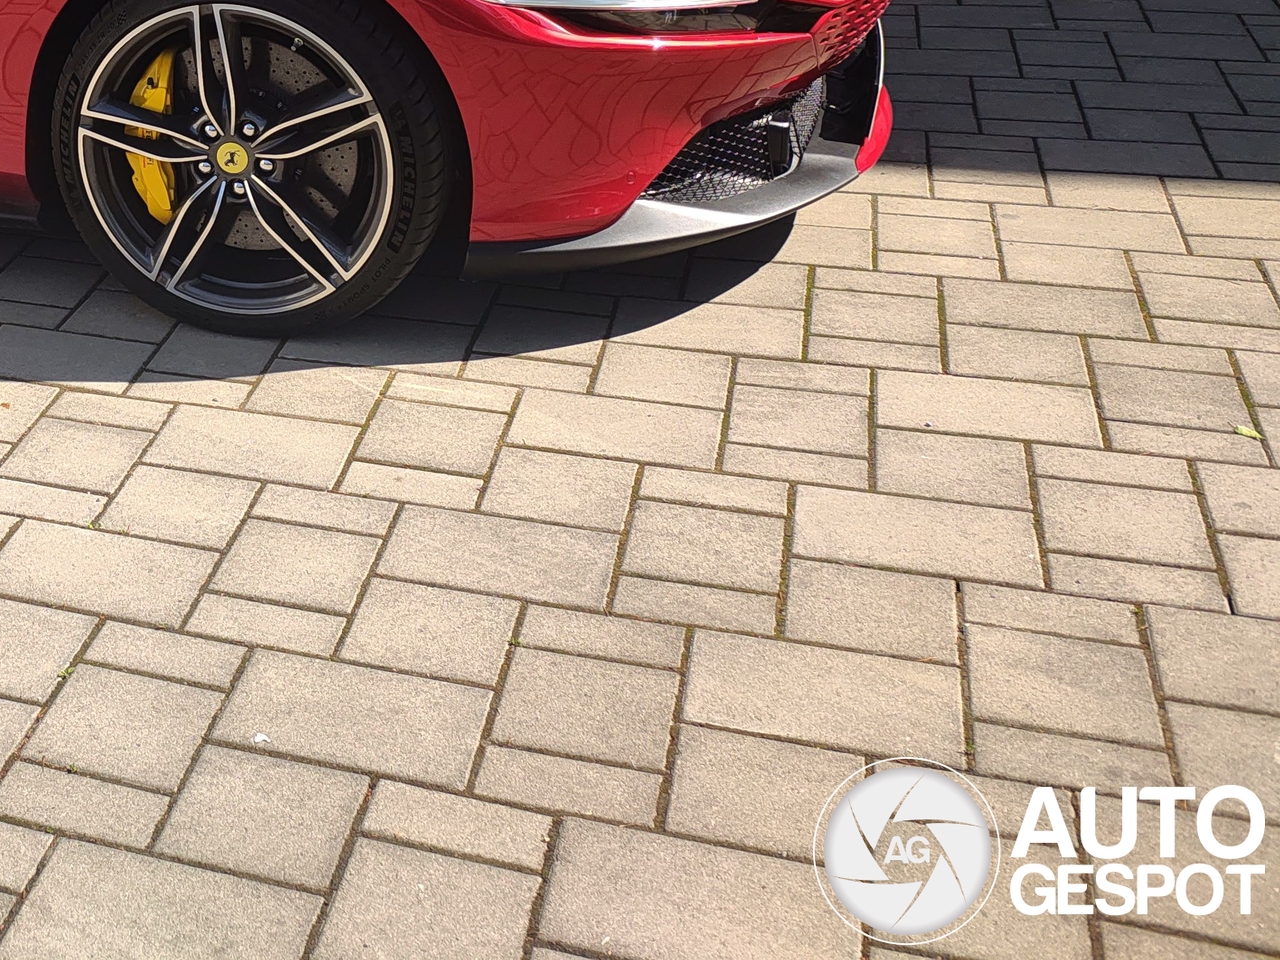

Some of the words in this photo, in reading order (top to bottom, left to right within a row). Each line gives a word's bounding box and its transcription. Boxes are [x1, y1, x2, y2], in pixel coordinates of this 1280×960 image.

[60, 81, 79, 186] MICHELIN
[390, 136, 417, 252] MICHELIN
[370, 258, 391, 283] PILOT
